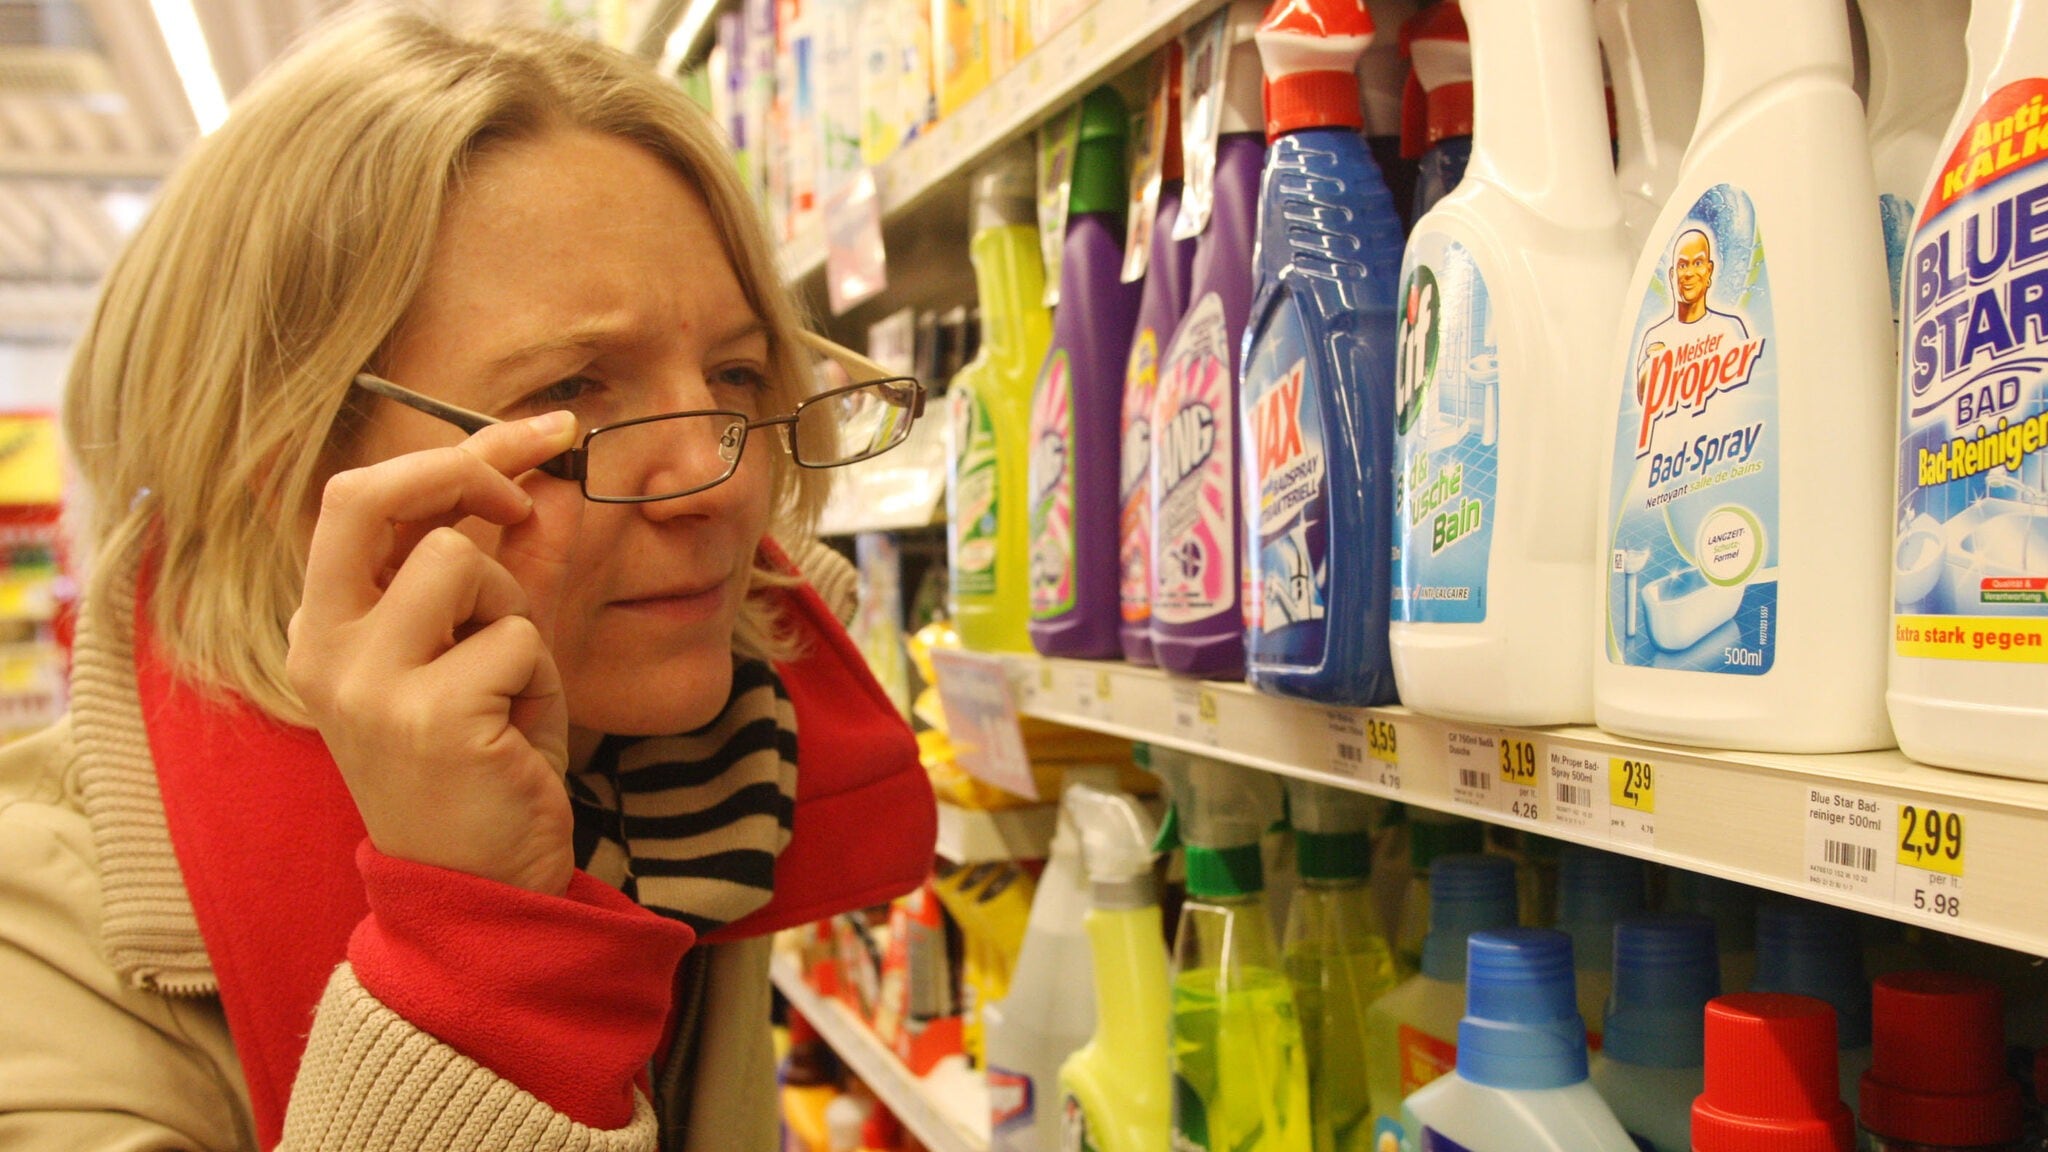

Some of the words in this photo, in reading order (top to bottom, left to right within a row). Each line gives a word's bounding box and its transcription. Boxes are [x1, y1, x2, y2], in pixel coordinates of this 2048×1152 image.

[1968, 93, 2048, 156] Anti-
[1942, 121, 2048, 201] KALK
[1912, 182, 2048, 320] BLUE
[1675, 334, 1724, 367] Meister
[1911, 268, 2048, 397] STAR
[1638, 339, 1760, 452] Proper
[1956, 376, 2020, 430] BAD
[1648, 423, 1762, 489] Bad-Spray
[1917, 411, 2048, 487] Bad-Reiniger
[1645, 484, 1689, 510] Nettoyant
[1690, 476, 1713, 491] salle
[1714, 469, 1728, 483] de
[1730, 460, 1763, 479] bains
[1432, 496, 1481, 554] Bain
[1707, 528, 1745, 546] LANGZEIT-
[1713, 550, 1740, 563] Formel
[1724, 647, 1762, 667] 500ml
[1924, 626, 1966, 644] stark
[1972, 631, 2042, 651] gegen
[1368, 718, 1397, 756] 3,59
[1501, 739, 1536, 781] 3,19
[1551, 766, 1571, 780] Spray
[1571, 770, 1593, 783] 500ml
[1511, 800, 1538, 820] 4.26
[1809, 808, 1845, 825] reiniger
[1849, 814, 1882, 831] 500ml
[1810, 790, 1830, 805] Blue
[1834, 795, 1854, 809] Star
[1857, 798, 1880, 813] Bad-
[1901, 805, 1962, 862] 2,99
[1929, 873, 1947, 886] per
[1914, 888, 1960, 918] 5.98
